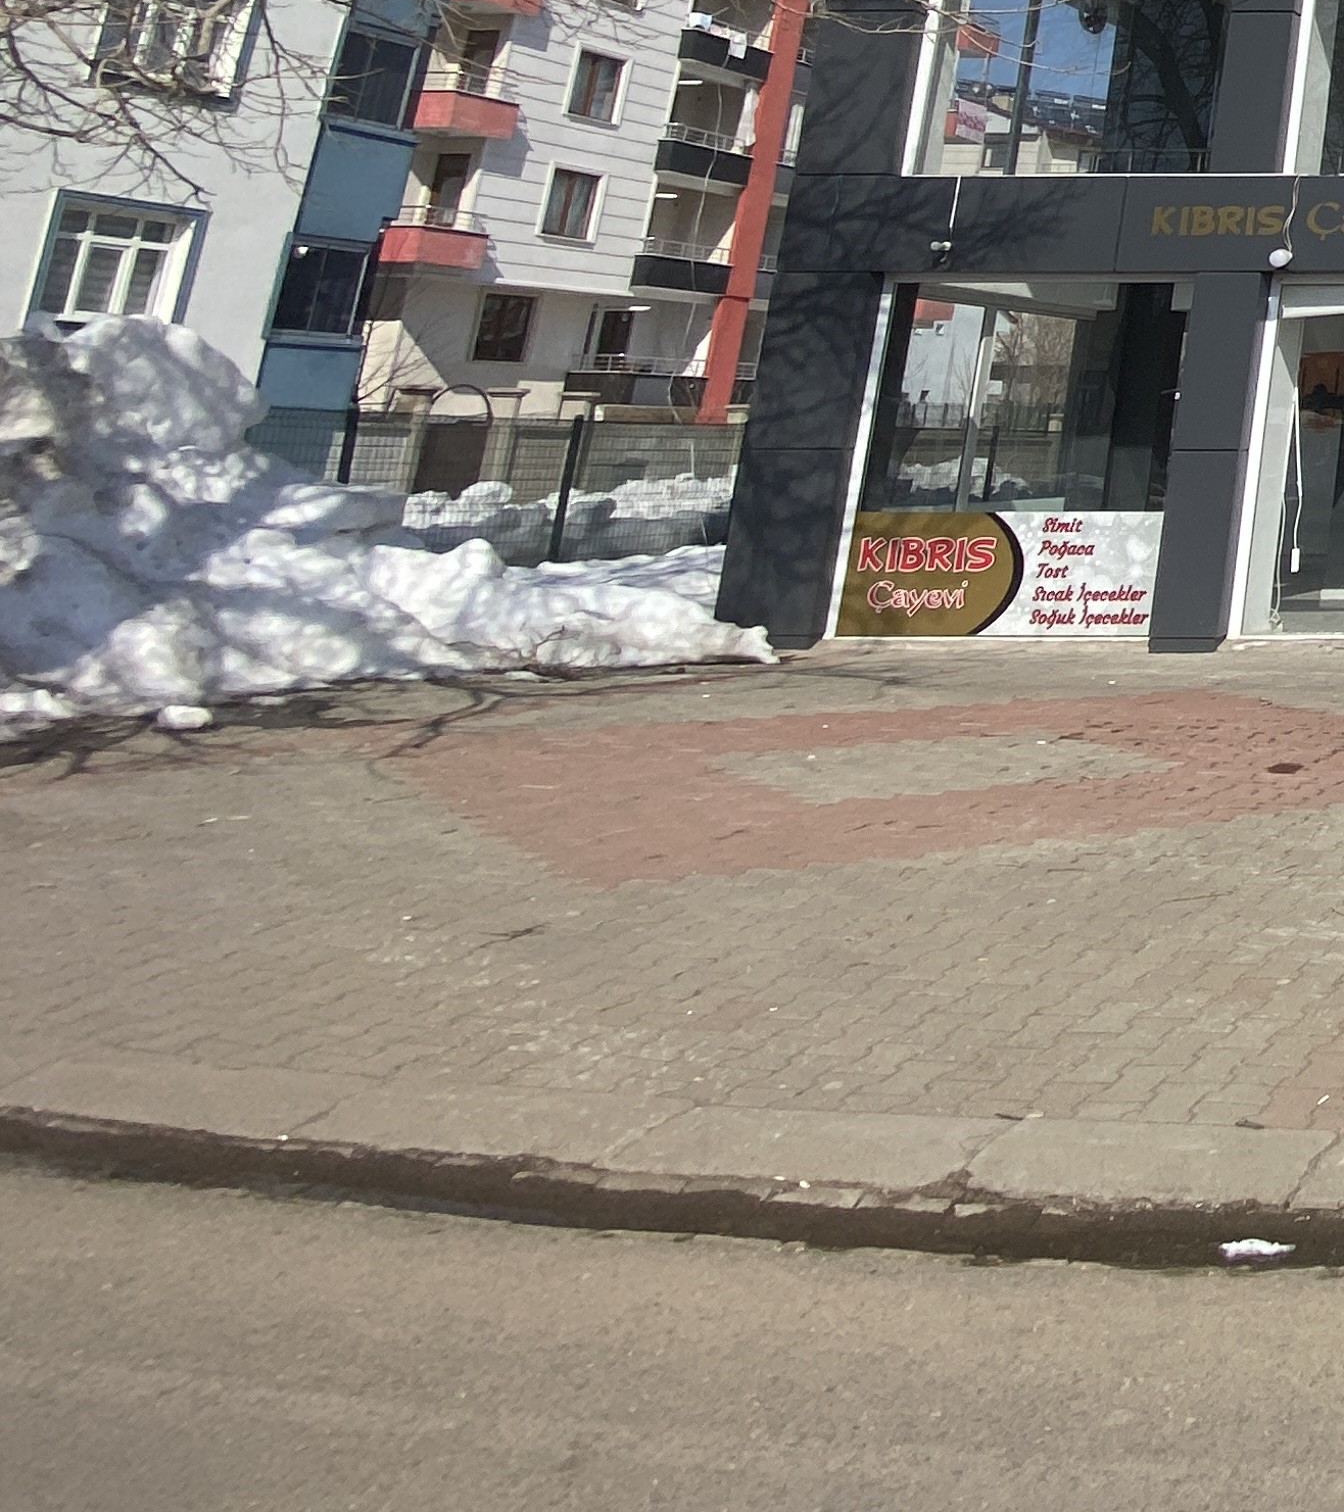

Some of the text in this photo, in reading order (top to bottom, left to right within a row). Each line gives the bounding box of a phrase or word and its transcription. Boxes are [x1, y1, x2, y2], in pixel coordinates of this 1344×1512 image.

[1151, 205, 1285, 237] KIBRIS
[1042, 517, 1084, 533] Simit
[857, 536, 998, 573] KIBRIS
[1035, 563, 1069, 578] Tost
[866, 580, 969, 617] Çayevi
[1032, 584, 1075, 602] Sıcak
[1029, 607, 1076, 630] Soğuk
